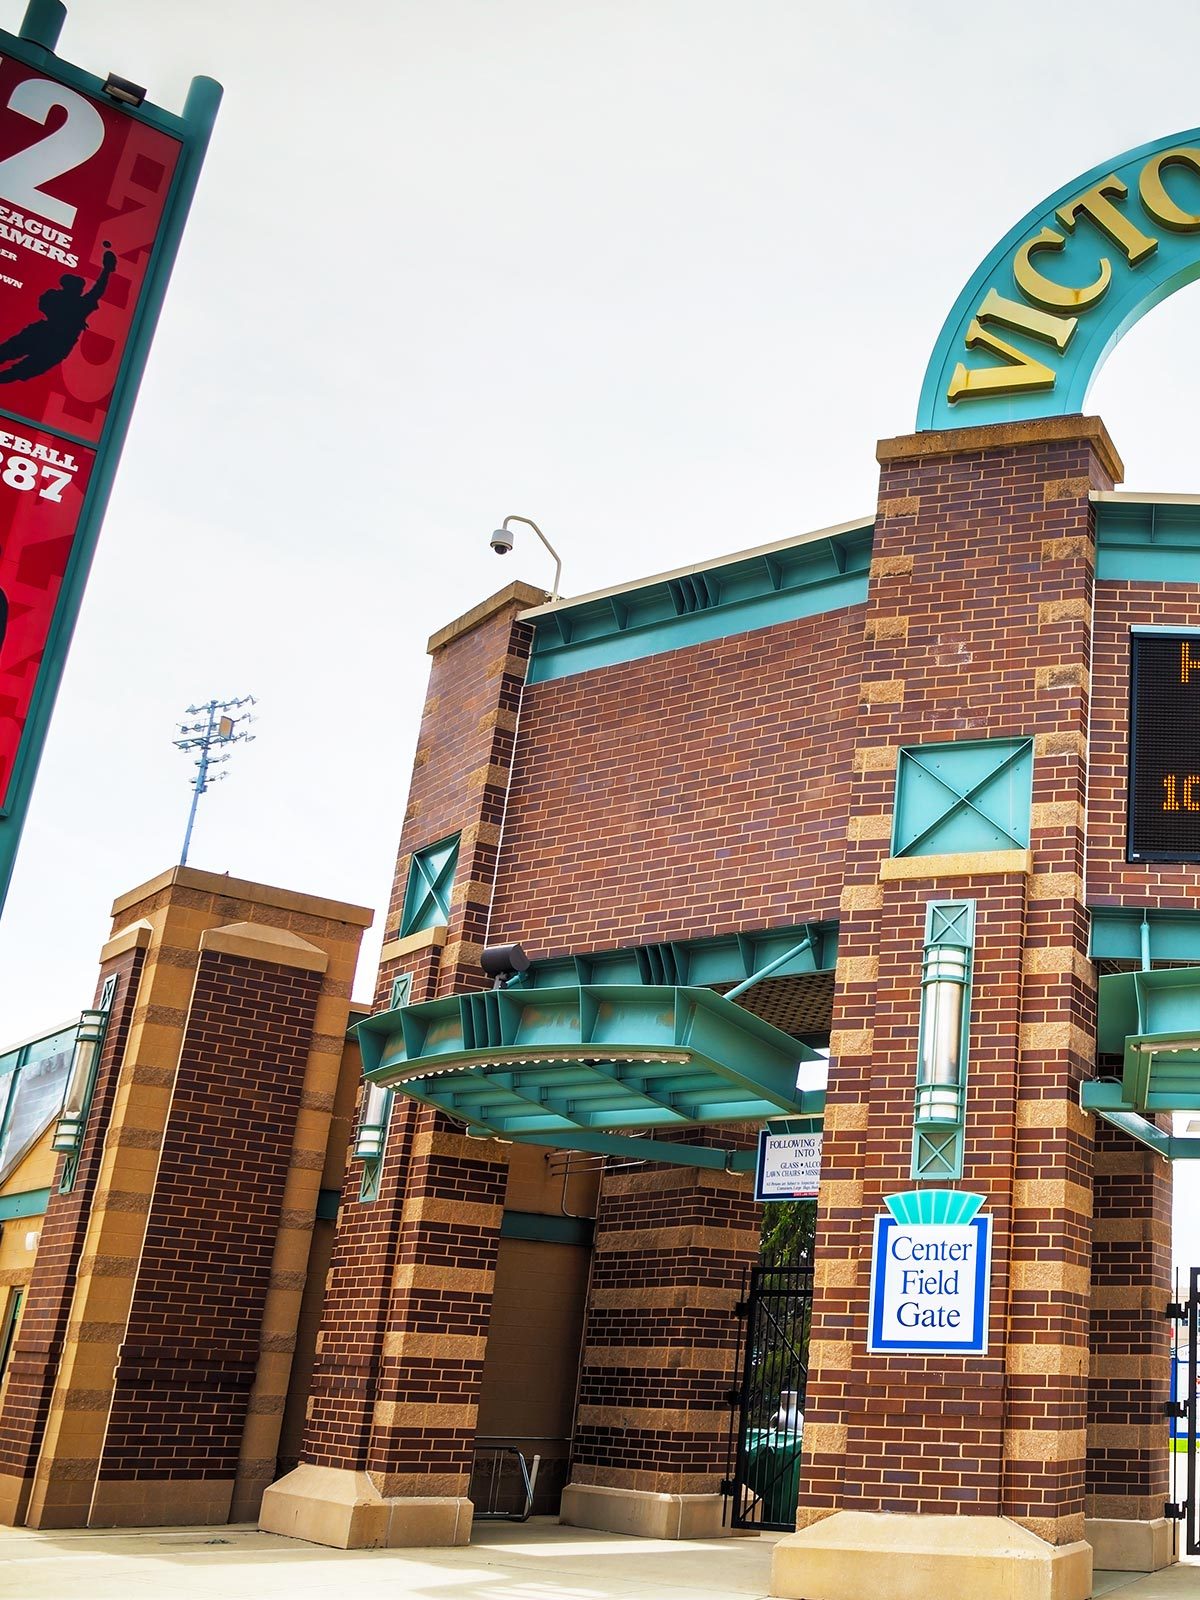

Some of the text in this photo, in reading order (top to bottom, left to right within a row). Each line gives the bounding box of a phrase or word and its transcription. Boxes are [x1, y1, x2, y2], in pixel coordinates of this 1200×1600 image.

[0, 57, 105, 229] 2
[0, 249, 17, 261] ER
[0, 452, 73, 503] 87
[769, 1138, 815, 1149] FOLLOWING
[794, 1148, 815, 1158] INTO
[780, 1162, 800, 1170] GLASS
[891, 1236, 973, 1261] Center
[900, 1269, 959, 1295] Field
[896, 1301, 961, 1328] Gate
